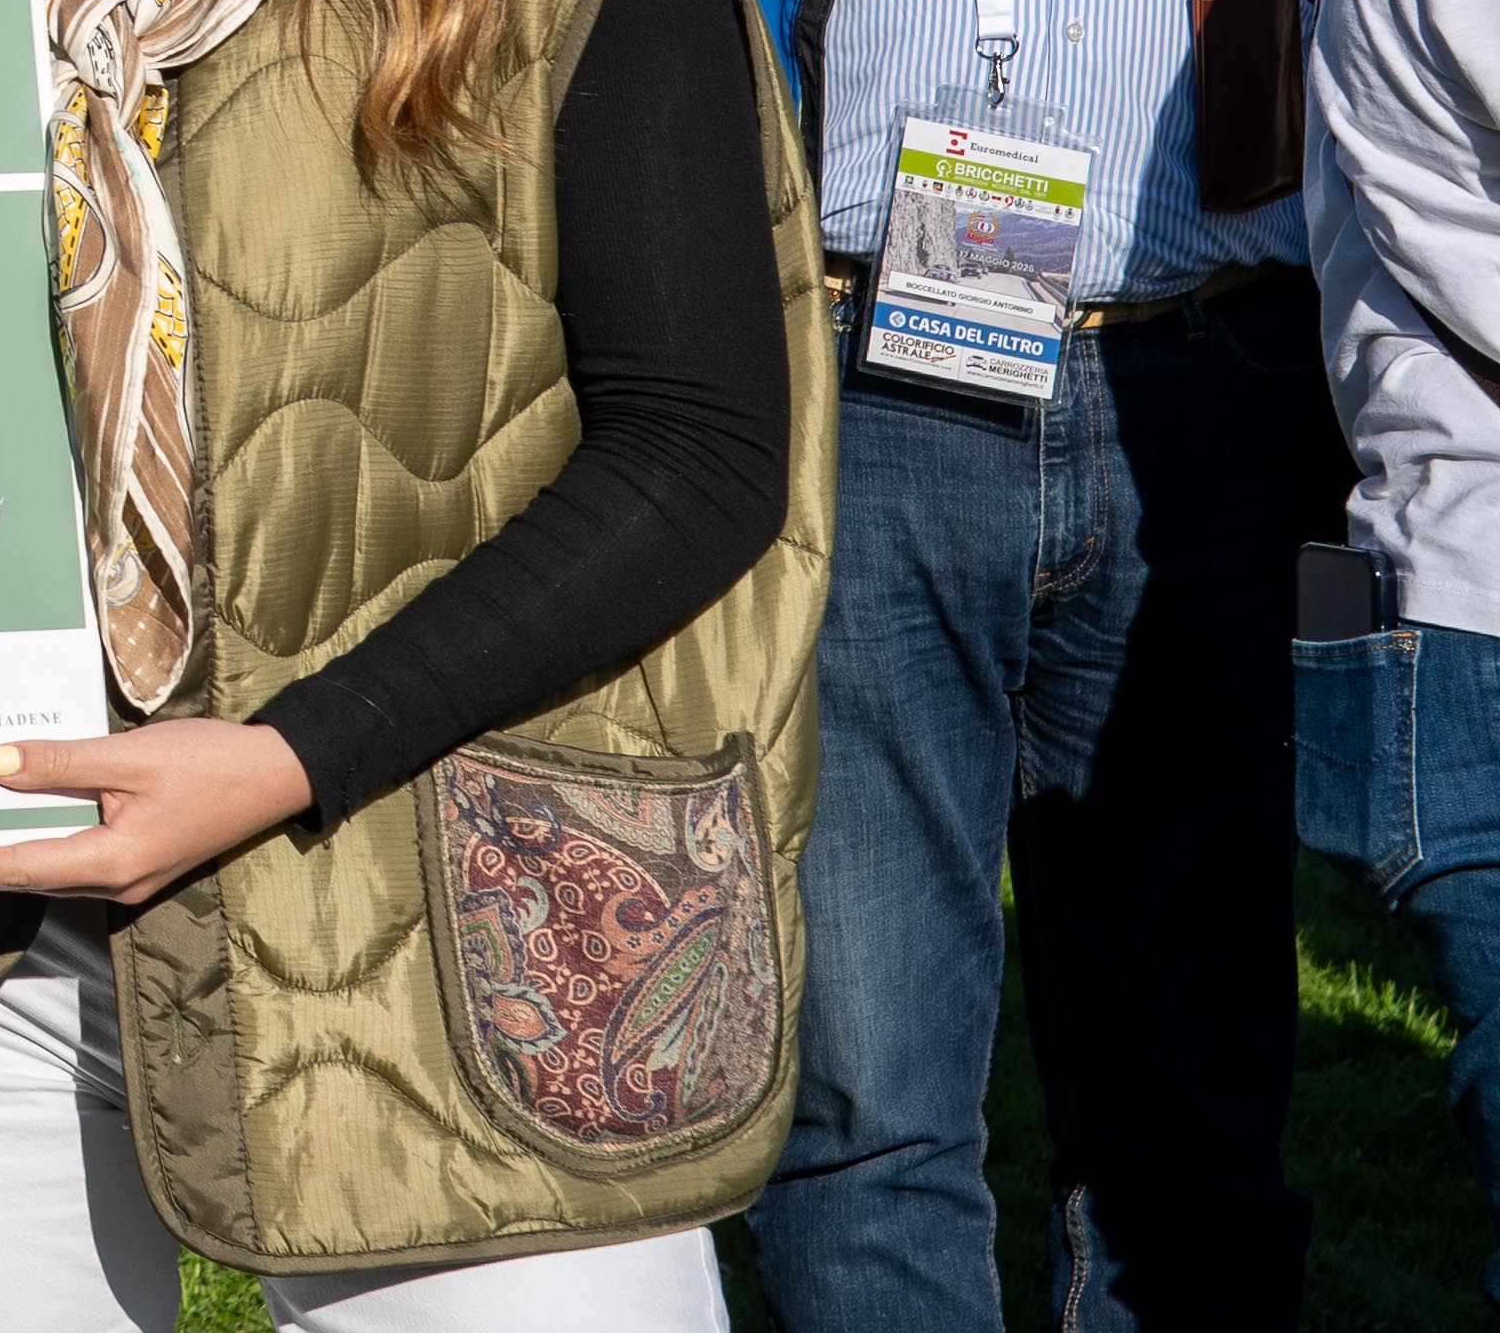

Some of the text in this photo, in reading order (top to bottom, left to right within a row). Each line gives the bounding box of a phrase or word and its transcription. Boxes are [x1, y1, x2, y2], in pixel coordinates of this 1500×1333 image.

[969, 141, 1040, 164] Euromedical
[954, 161, 1050, 194] BRICCHETTI
[969, 253, 1011, 269] MAGGIO
[905, 281, 958, 299] BOCCELLATO
[957, 292, 993, 307] GIORGIO
[882, 332, 957, 356] COLORIFICIO
[908, 315, 1045, 357] CASA DEL FILTRO
[881, 343, 932, 362] ASTRALE
[987, 364, 1049, 384] MERIGHETTI
